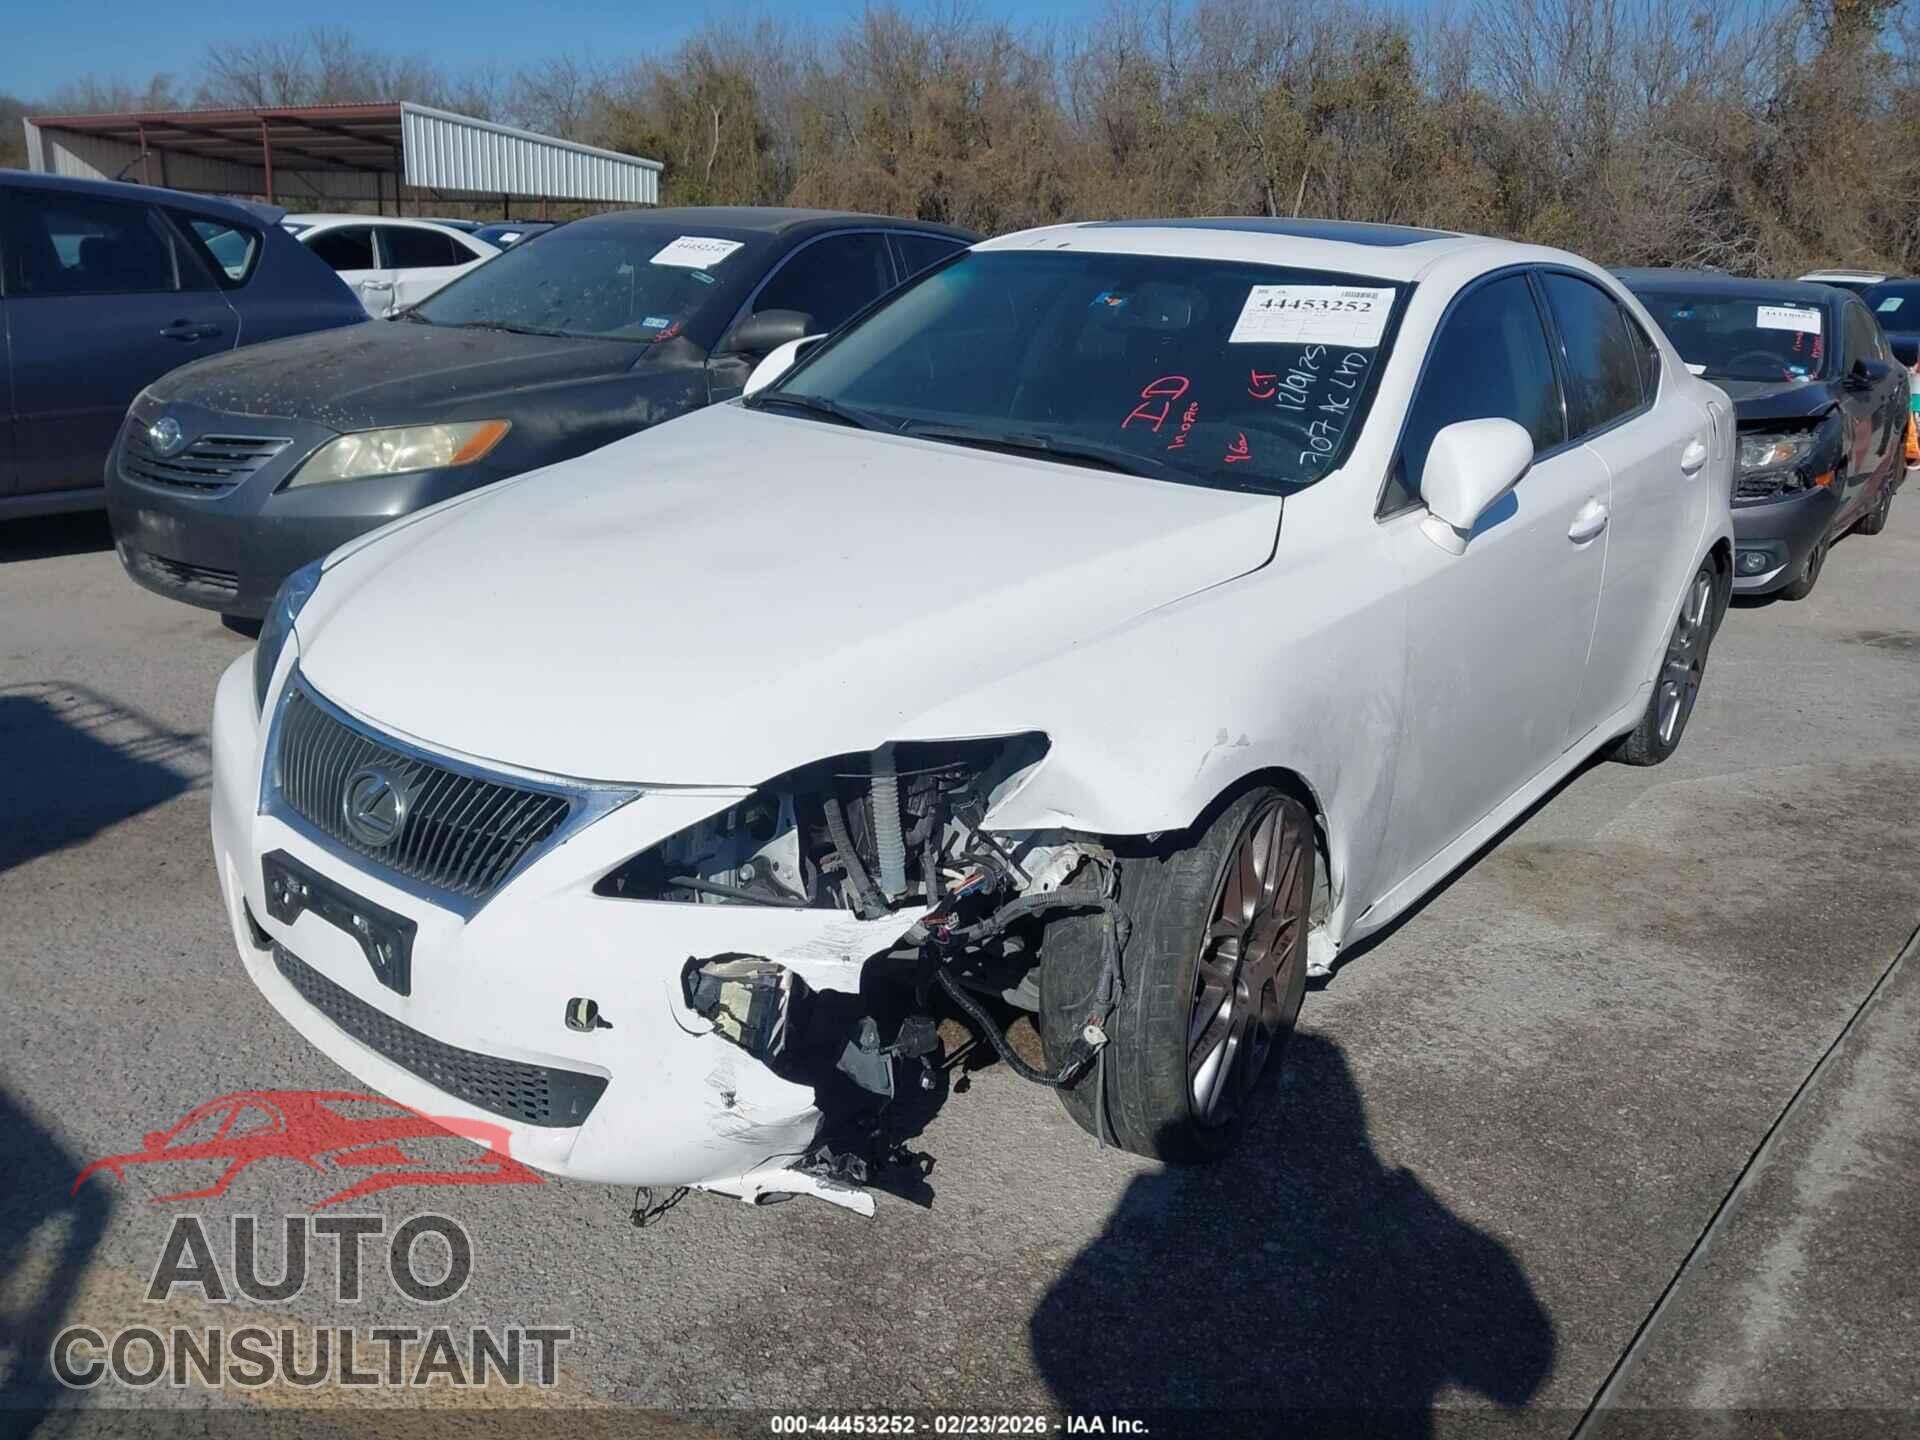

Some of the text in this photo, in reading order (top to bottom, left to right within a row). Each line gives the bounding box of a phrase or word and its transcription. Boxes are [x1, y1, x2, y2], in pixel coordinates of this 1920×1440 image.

[1260, 298, 1372, 313] 44453252
[1121, 376, 1190, 432] ID
[1300, 420, 1340, 467] 707
